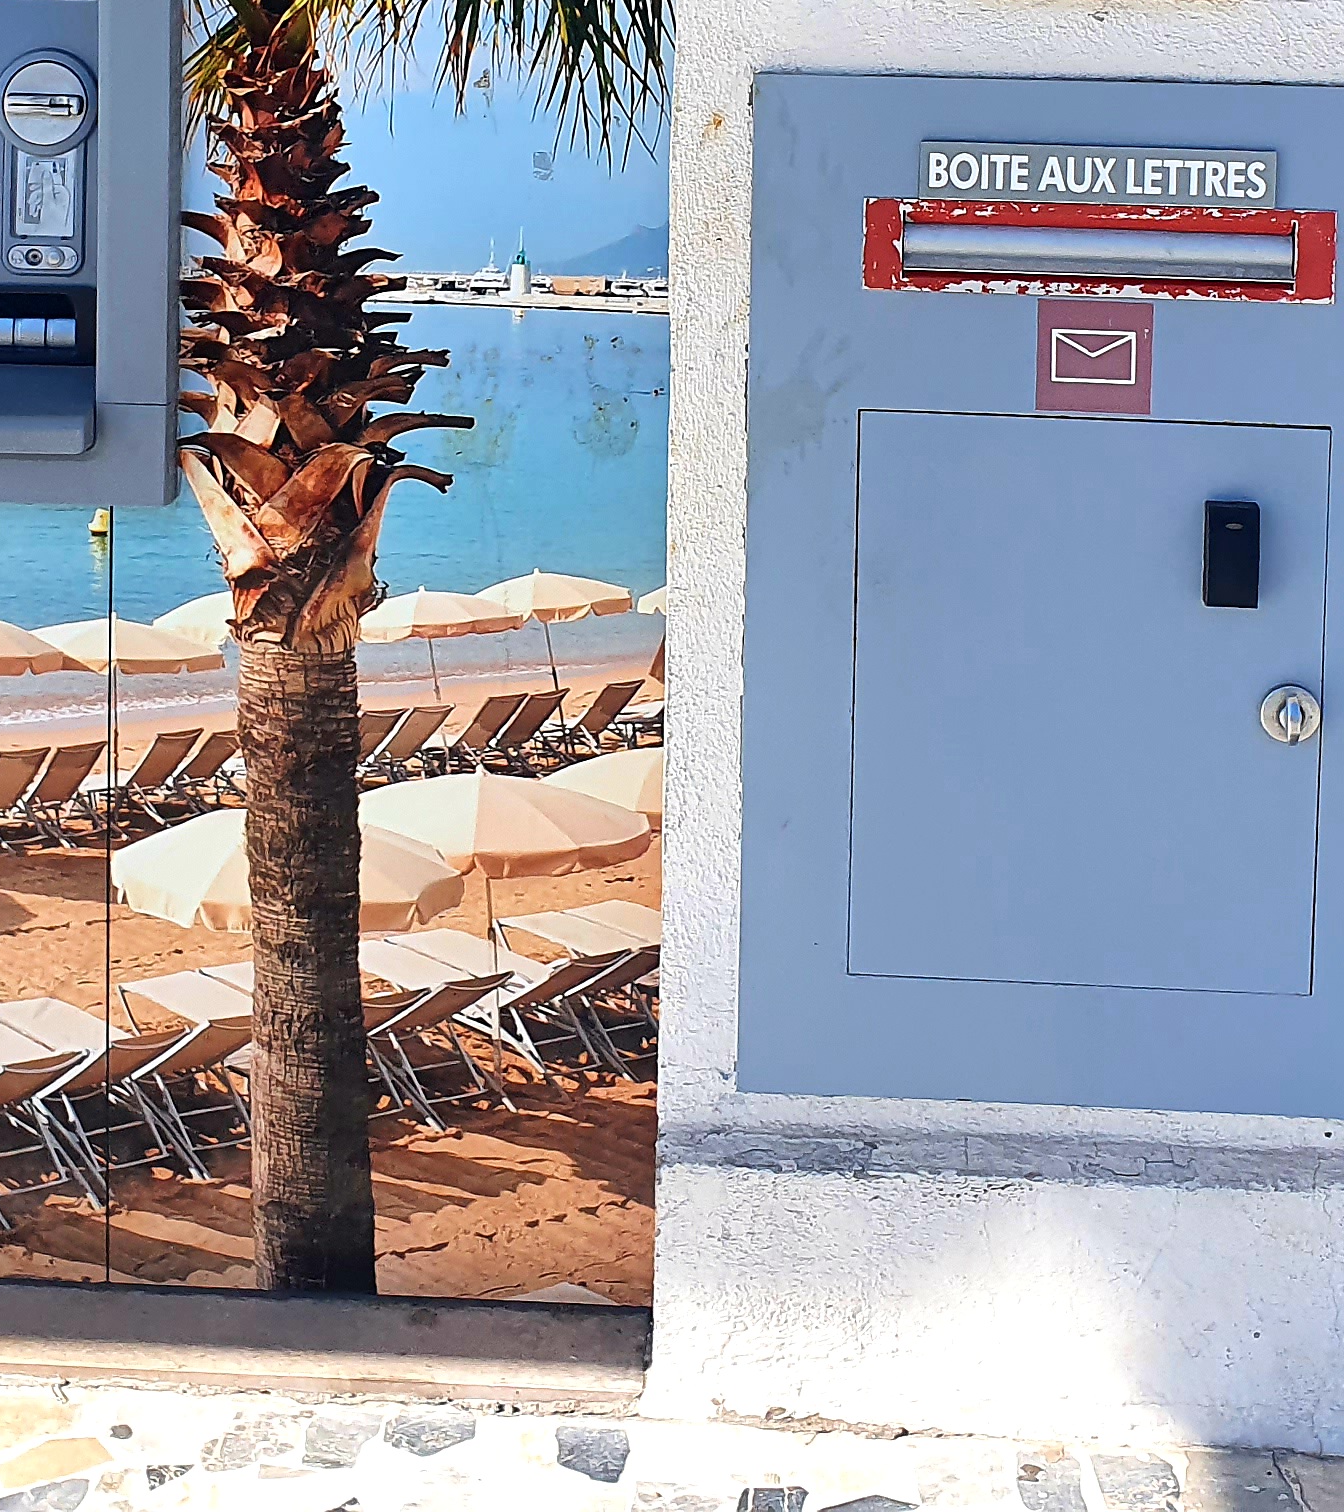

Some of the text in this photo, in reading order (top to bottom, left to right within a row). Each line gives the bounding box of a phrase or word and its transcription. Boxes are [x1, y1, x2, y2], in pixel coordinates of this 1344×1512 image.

[928, 152, 1267, 200] BOITE AUX LETTRES
